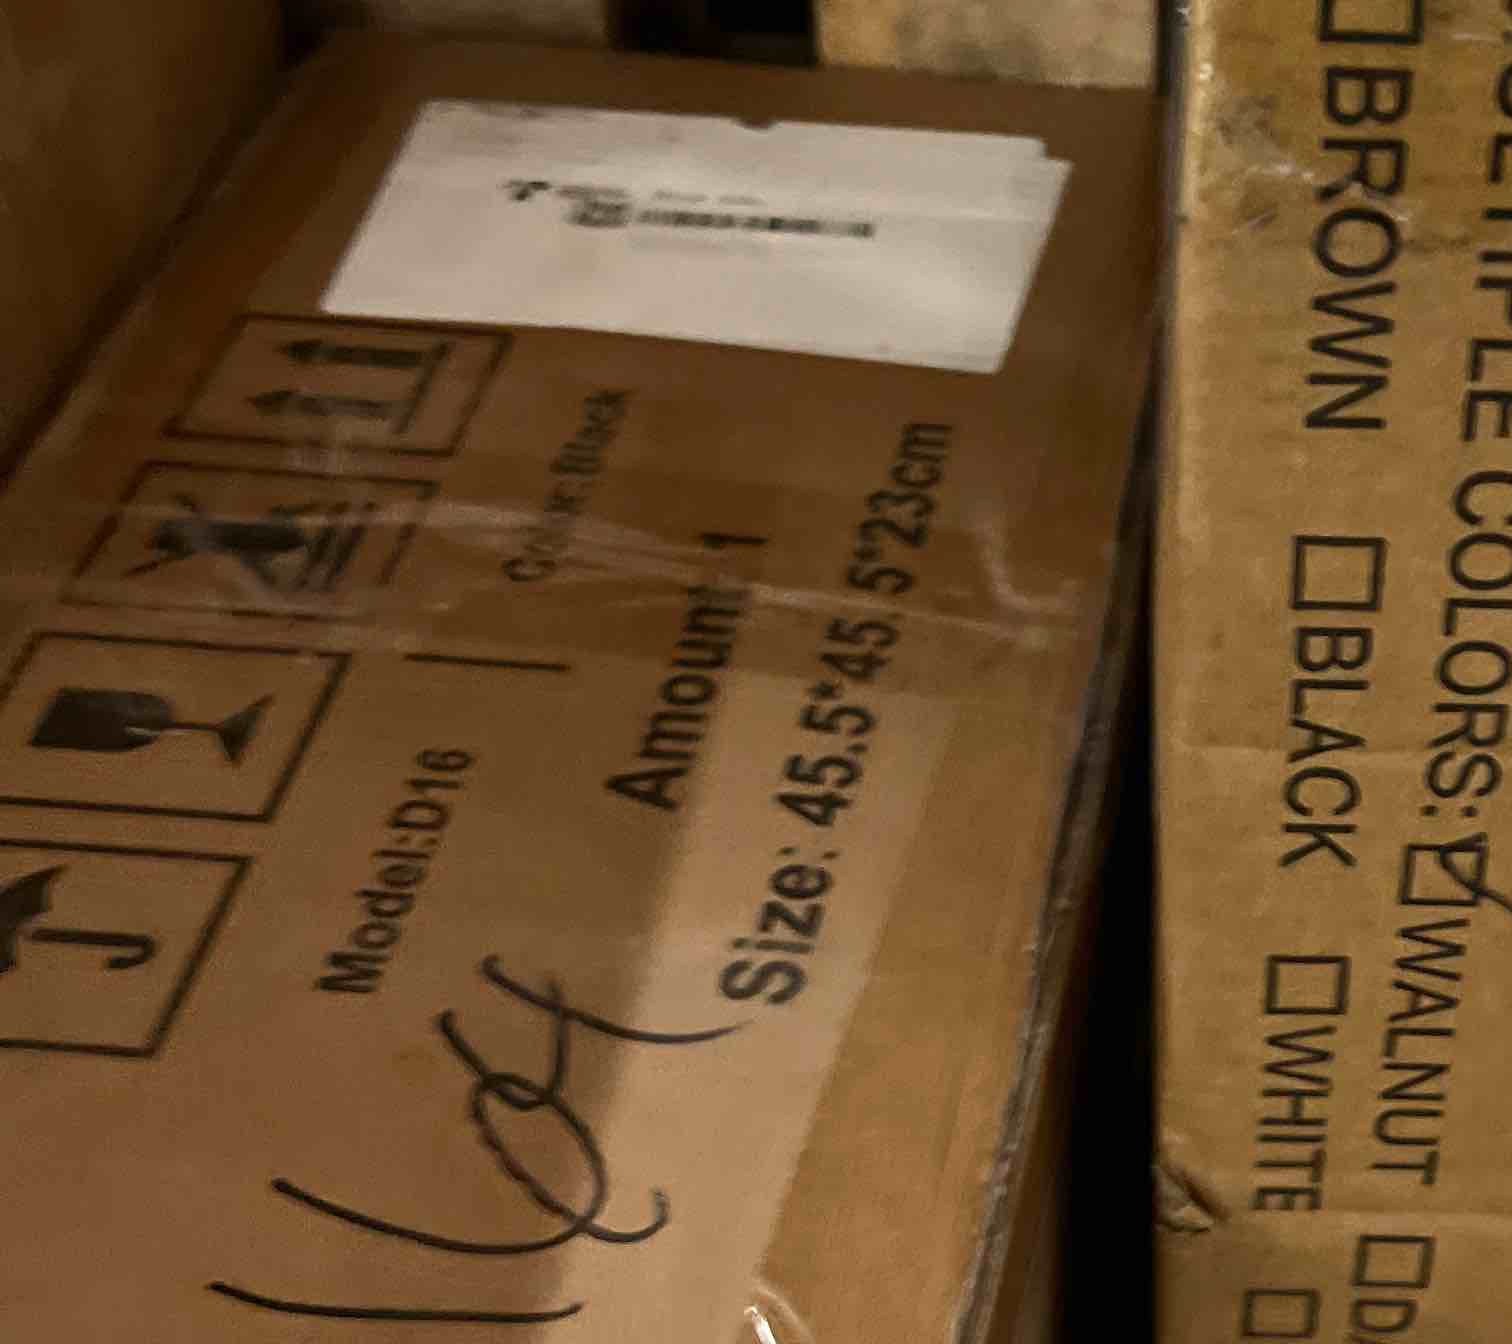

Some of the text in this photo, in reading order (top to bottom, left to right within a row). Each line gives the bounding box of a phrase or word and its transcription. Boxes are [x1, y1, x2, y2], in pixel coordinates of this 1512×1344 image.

[1302, 65, 1414, 433] BROWN
[603, 585, 750, 812] Amount
[1277, 625, 1374, 868] BLACK
[718, 846, 840, 1006] Size:
[1251, 1024, 1339, 1212] WHITE
[1371, 916, 1473, 1186] WALNUT
